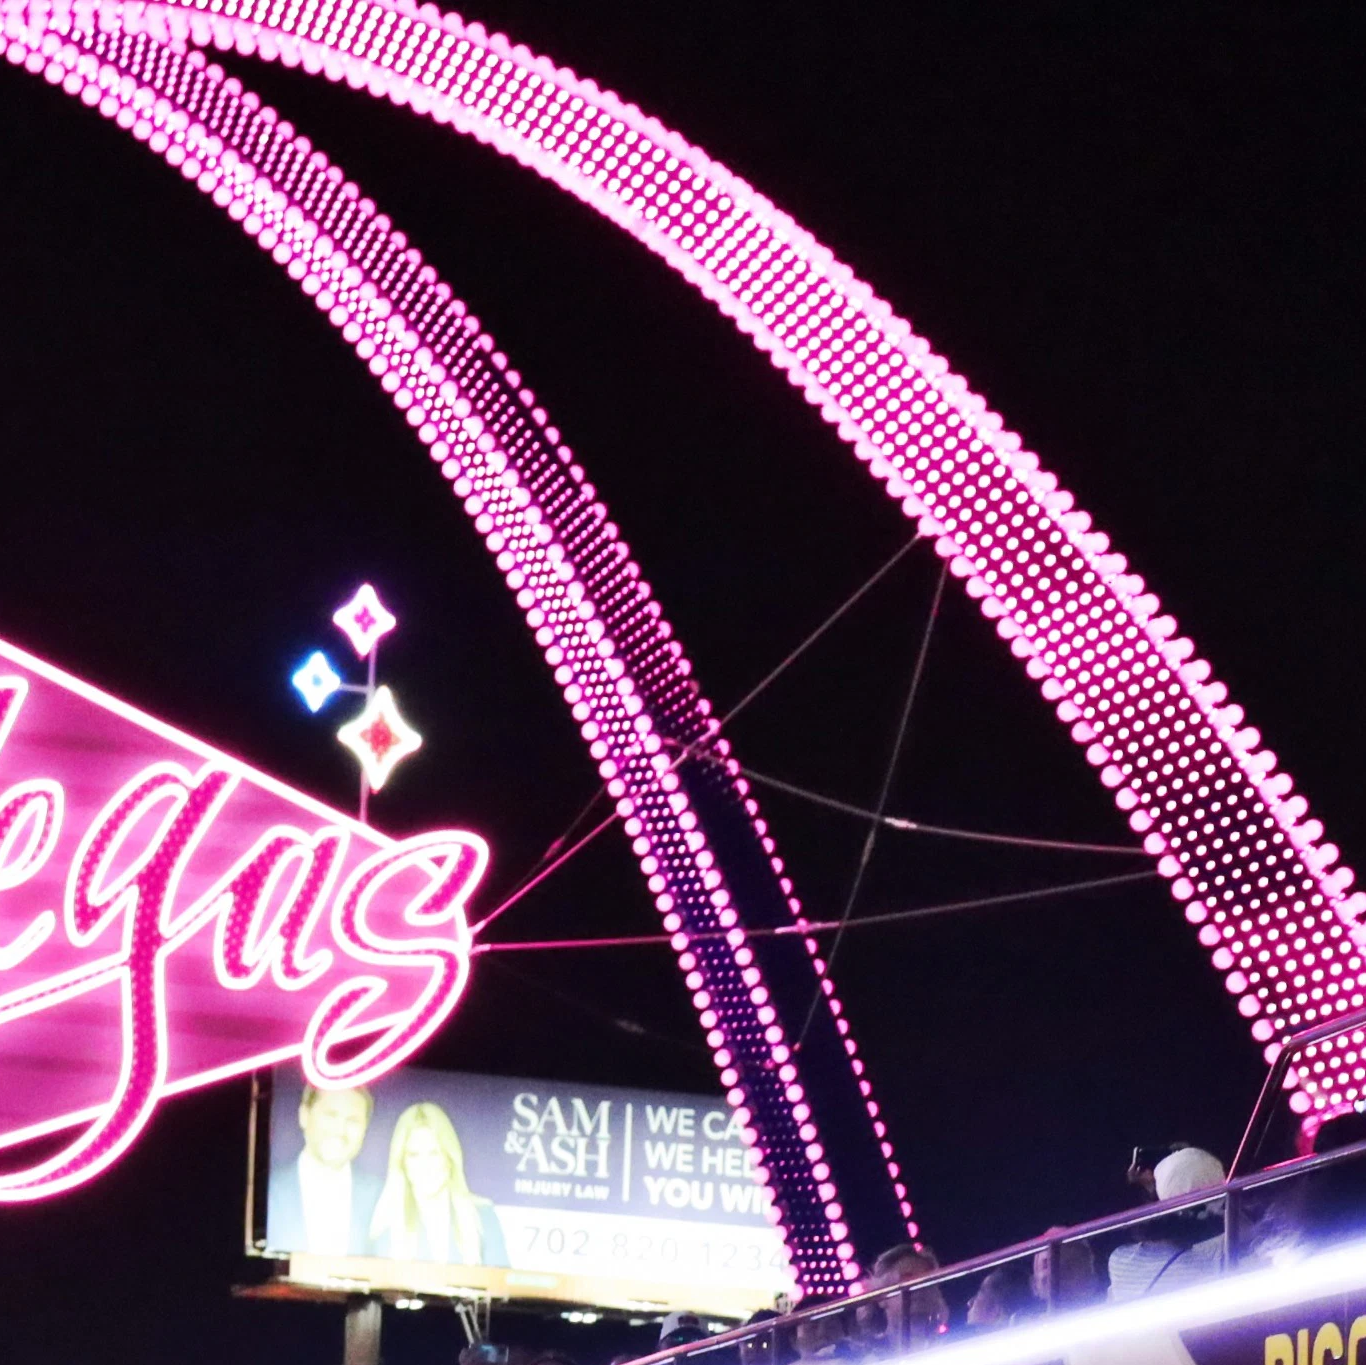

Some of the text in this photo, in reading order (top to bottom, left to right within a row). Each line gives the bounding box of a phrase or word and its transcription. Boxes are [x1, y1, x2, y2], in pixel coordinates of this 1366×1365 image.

[511, 1092, 612, 1138] SAM
[644, 1103, 749, 1142] WE CA
[643, 1139, 759, 1179] WE HEL
[514, 1178, 611, 1201] INJURY LAW
[643, 1175, 771, 1215] YOU WI
[523, 1225, 591, 1257] 702
